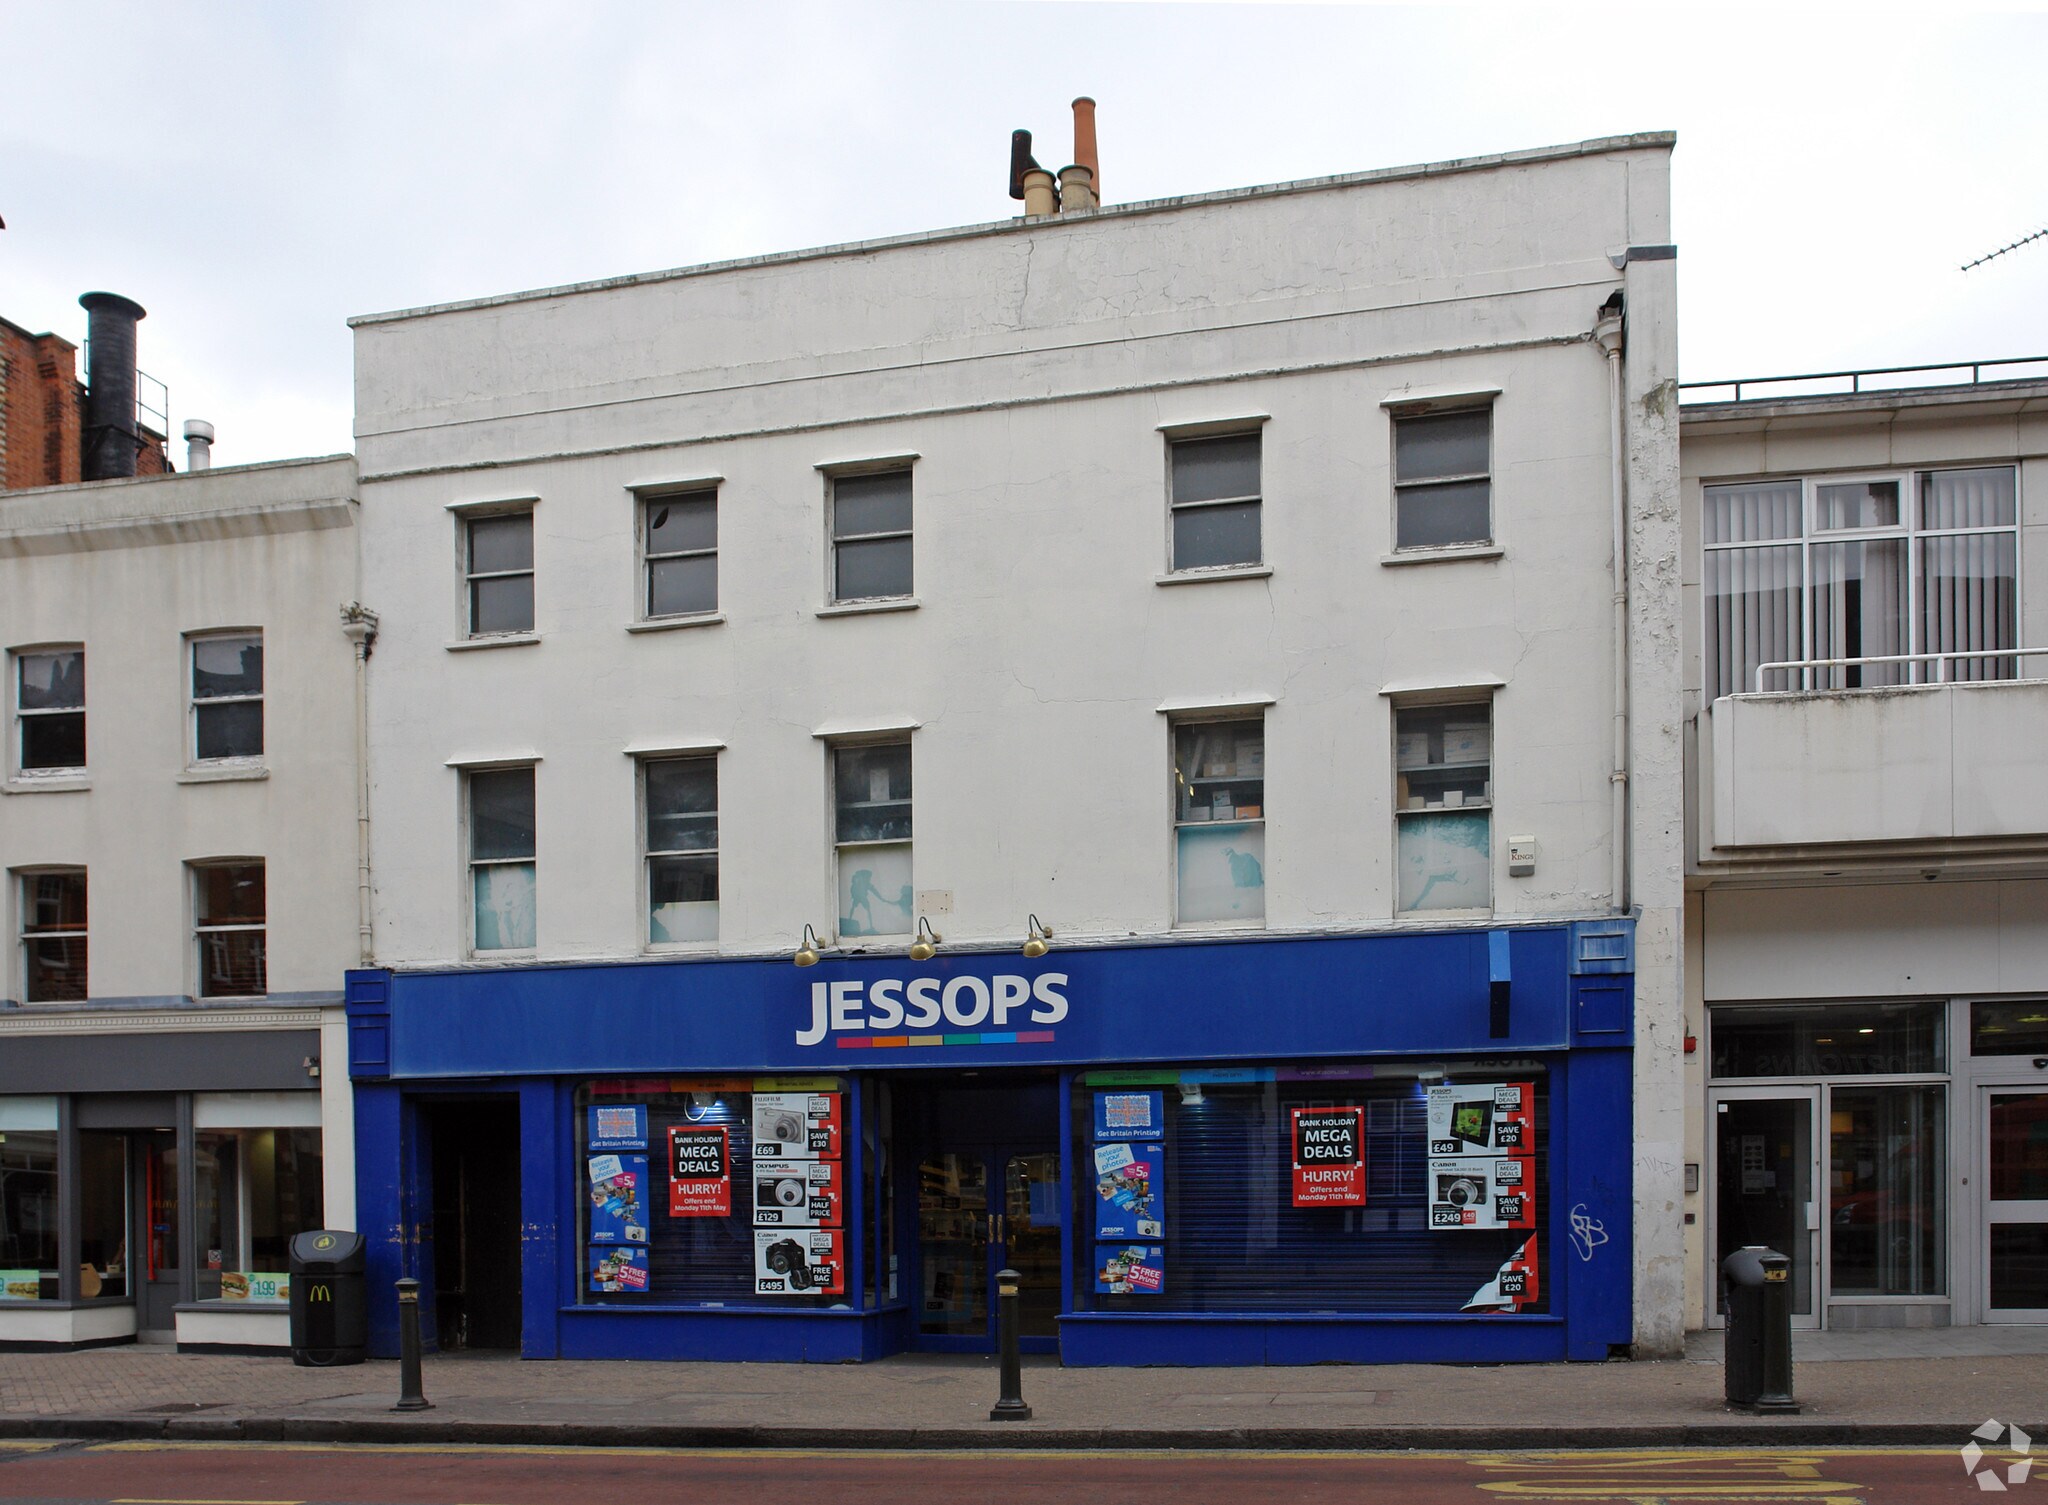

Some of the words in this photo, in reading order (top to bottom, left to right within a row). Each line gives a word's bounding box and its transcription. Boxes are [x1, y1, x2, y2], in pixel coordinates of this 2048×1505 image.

[796, 972, 1069, 1046] JESSOPS
[1306, 1129, 1351, 1142] MEGA
[1498, 1126, 1520, 1134] SAVE
[1501, 1135, 1517, 1143] £20
[680, 1146, 718, 1158] MEGA
[757, 1146, 775, 1155] £69
[1304, 1145, 1353, 1159] DEALS
[1434, 1143, 1454, 1153] £49
[679, 1161, 720, 1173] DEALS
[1101, 1158, 1128, 1171] photos
[1136, 1166, 1148, 1178] 5p
[1303, 1171, 1354, 1183] HURRY!
[624, 1176, 635, 1187] 5p
[678, 1184, 721, 1195] HURRY!
[1499, 1197, 1520, 1205] SAVE
[1501, 1206, 1518, 1214] £110
[758, 1213, 779, 1221] £129
[1434, 1214, 1461, 1223] £249
[619, 1266, 629, 1278] 5
[628, 1267, 647, 1278] FREE
[1129, 1266, 1141, 1279] 5
[1141, 1268, 1162, 1279] FREE
[1502, 1275, 1524, 1283] SAVE
[760, 1282, 782, 1290] £495
